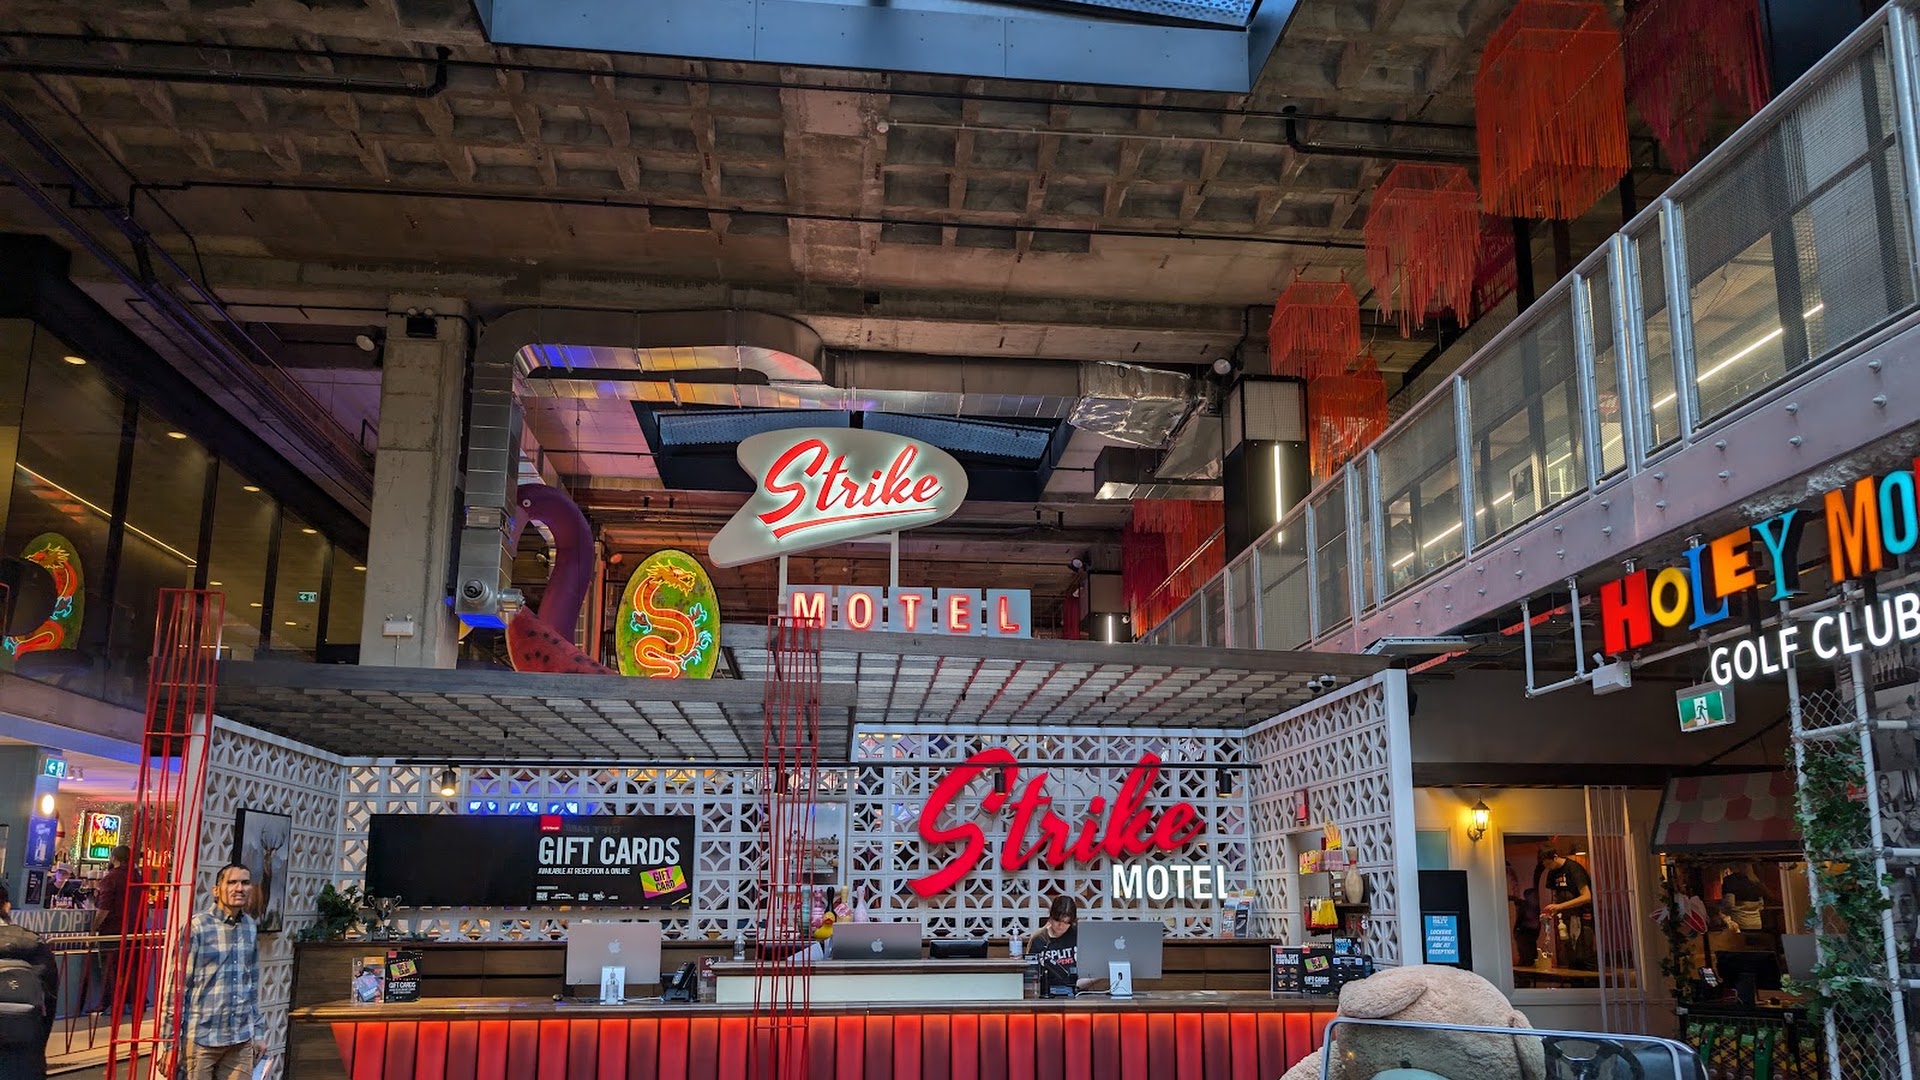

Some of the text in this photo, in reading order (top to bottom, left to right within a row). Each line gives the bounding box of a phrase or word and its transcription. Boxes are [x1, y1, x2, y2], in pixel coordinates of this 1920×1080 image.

[757, 438, 943, 525] Strike
[1600, 457, 1920, 657] HOLEY MO
[792, 592, 1020, 634] MOTEL
[1711, 592, 1920, 686] GOLF CLUB
[907, 748, 1205, 898] Strike
[538, 836, 680, 865] GIFT CARDS
[537, 867, 631, 875] AVAILABLE AT RECEPTION & ONLINE
[652, 869, 671, 882] GIFT
[656, 879, 676, 892] CARD
[1112, 864, 1228, 899] MOTEL
[11, 909, 93, 932] KINNY DIPP
[1045, 947, 1072, 959] SPLIT
